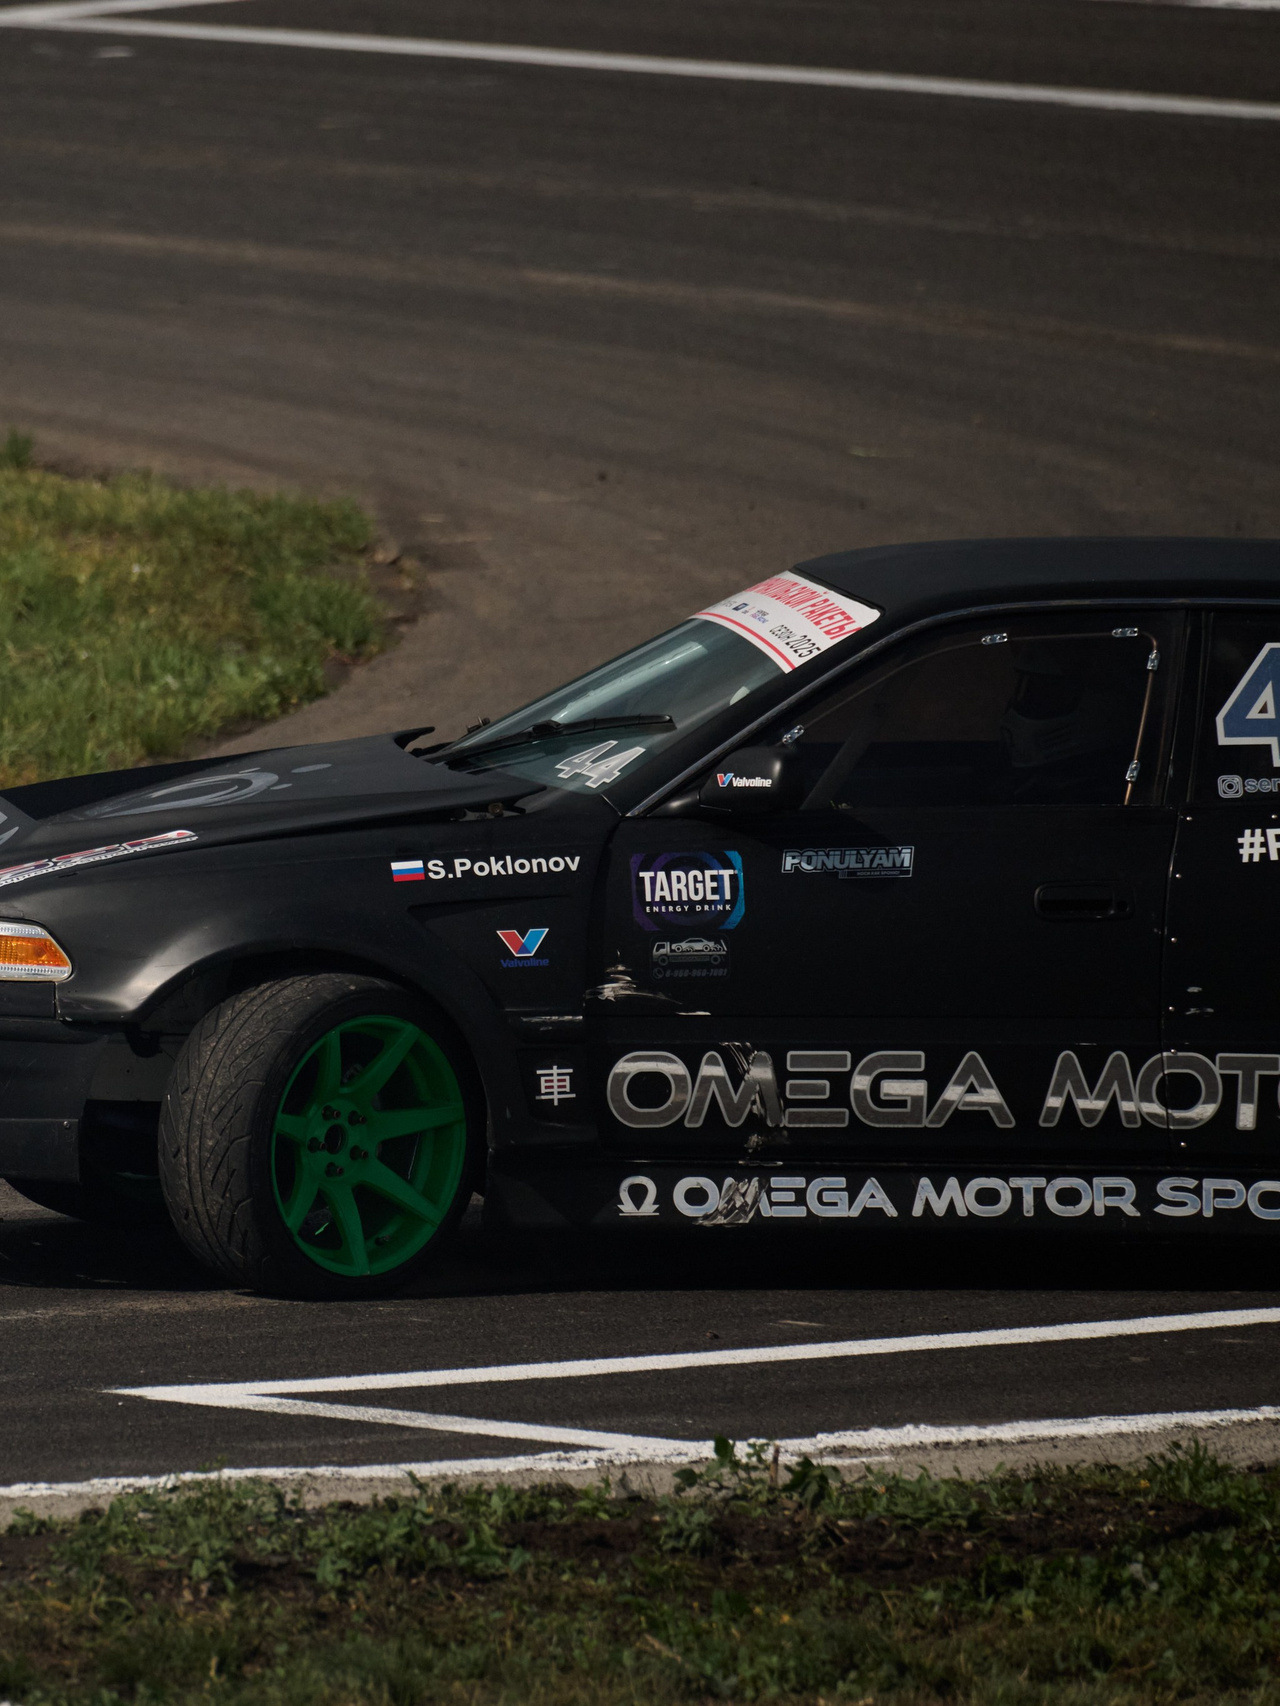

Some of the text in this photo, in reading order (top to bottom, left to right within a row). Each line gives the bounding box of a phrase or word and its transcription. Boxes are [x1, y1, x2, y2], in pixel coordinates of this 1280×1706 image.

[801, 599, 863, 641] РАКЕТЫ
[784, 635, 822, 659] 2025
[554, 739, 647, 789] 44
[732, 776, 773, 788] Valvoline
[427, 855, 581, 880] S.Poklonov
[783, 848, 912, 872] PONULYAM
[639, 869, 734, 903] TARGET
[645, 904, 732, 913] ENERGY DRINK
[499, 957, 550, 969] Valvoline
[535, 1065, 576, 1107] 車
[606, 1050, 1280, 1131] OMEGA MOT
[911, 1176, 1141, 1218] MOTOR
